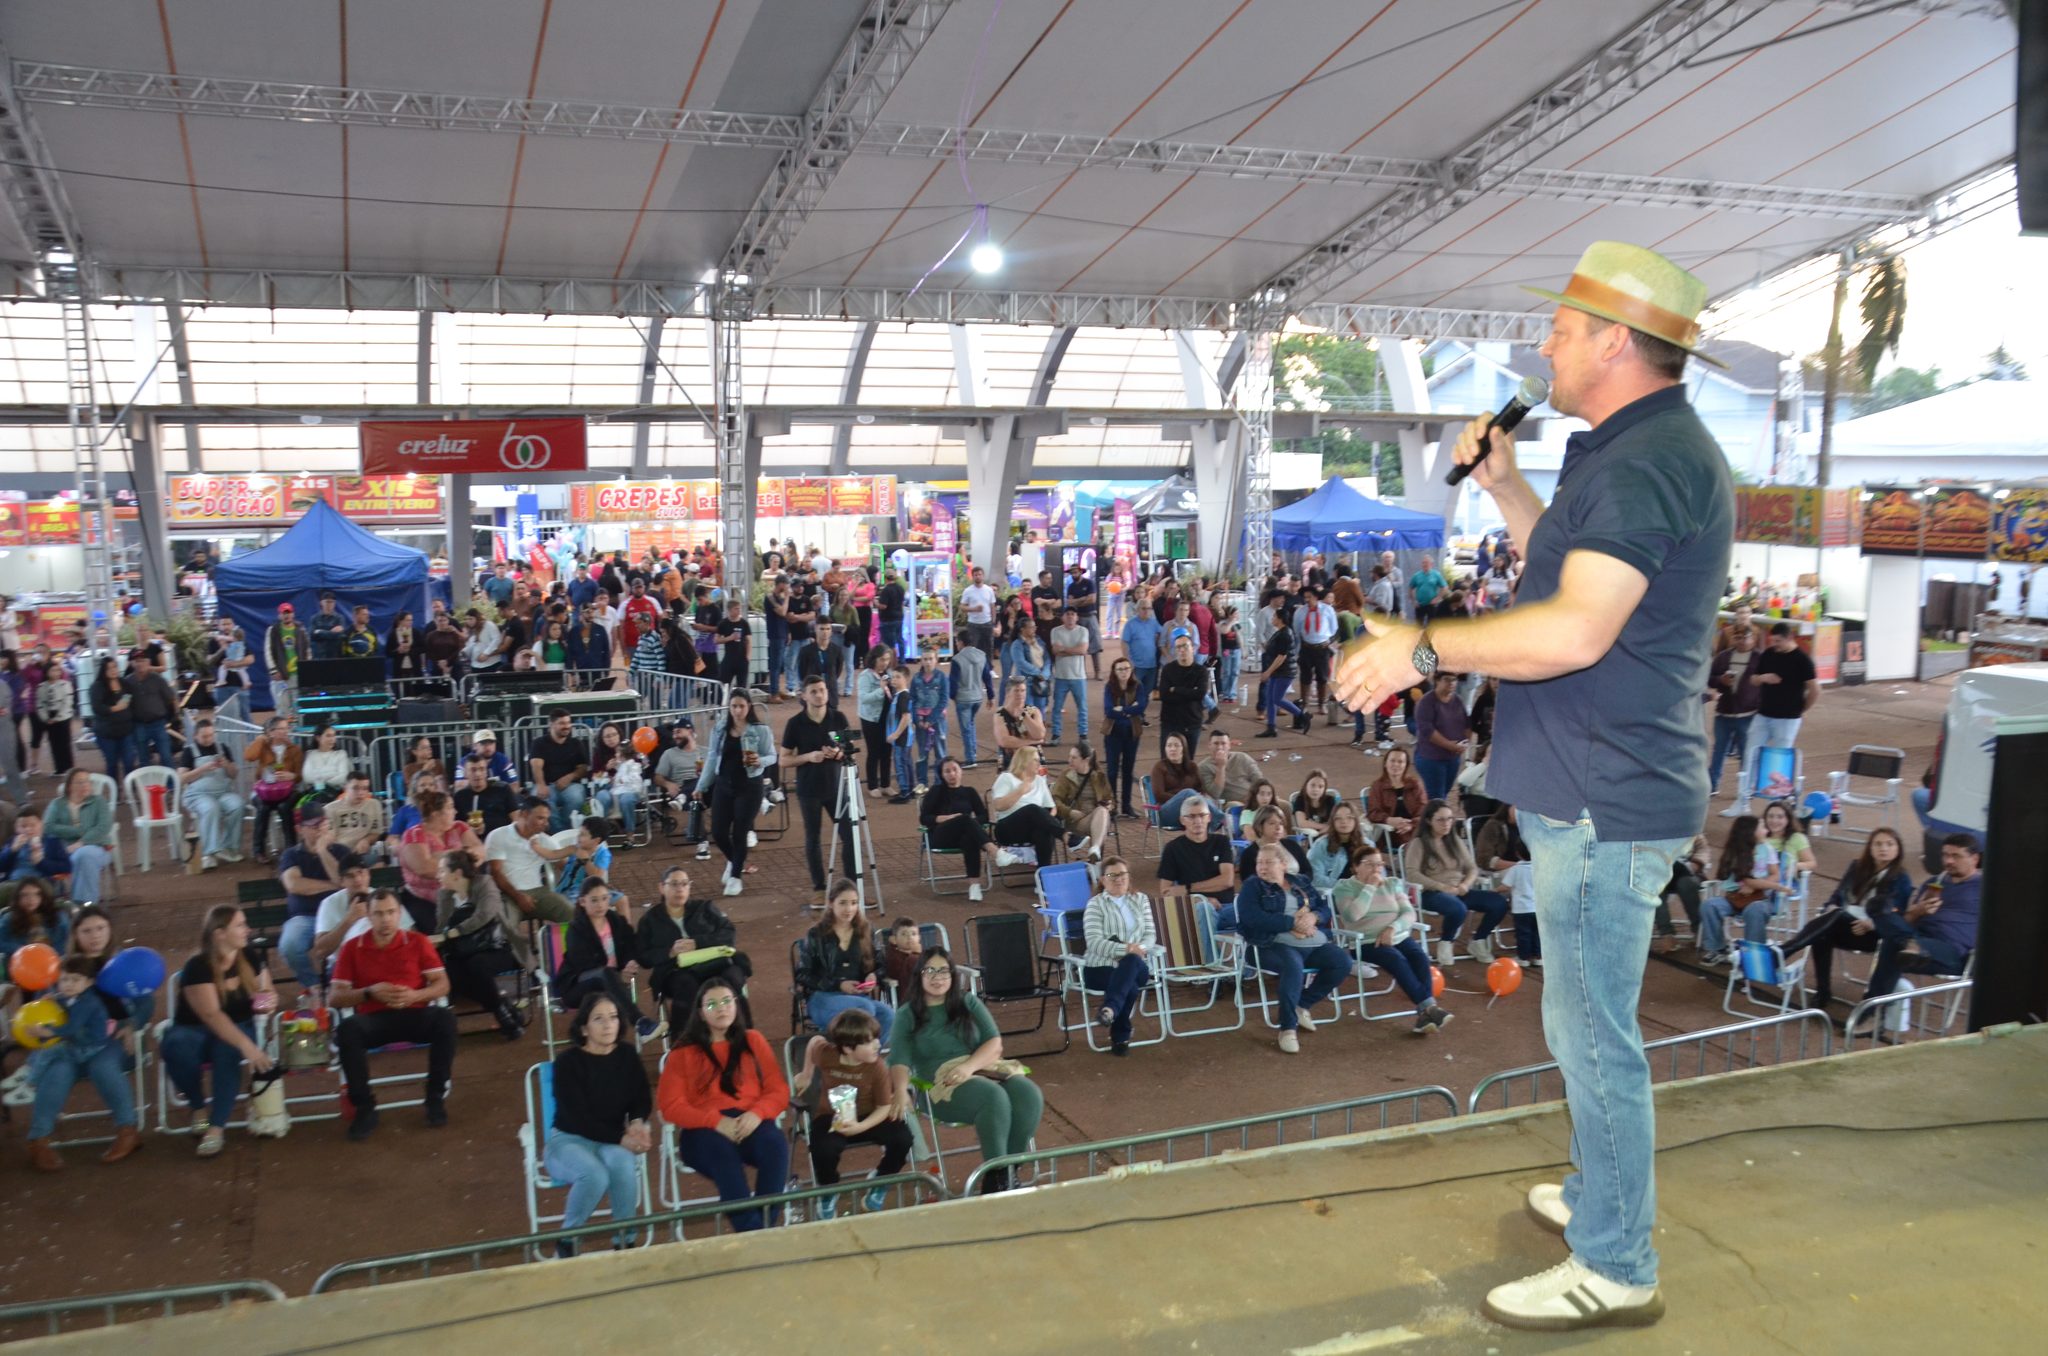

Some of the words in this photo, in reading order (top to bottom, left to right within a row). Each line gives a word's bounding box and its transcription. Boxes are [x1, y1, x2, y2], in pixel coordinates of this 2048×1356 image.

[398, 433, 470, 455] creluz
[498, 421, 551, 470] 60
[179, 480, 250, 500] SUPER
[291, 479, 330, 489] XIS
[363, 478, 416, 498] XIS
[342, 498, 437, 511] ENTREVERO
[599, 486, 686, 508] CREPES
[757, 494, 782, 506] EPE
